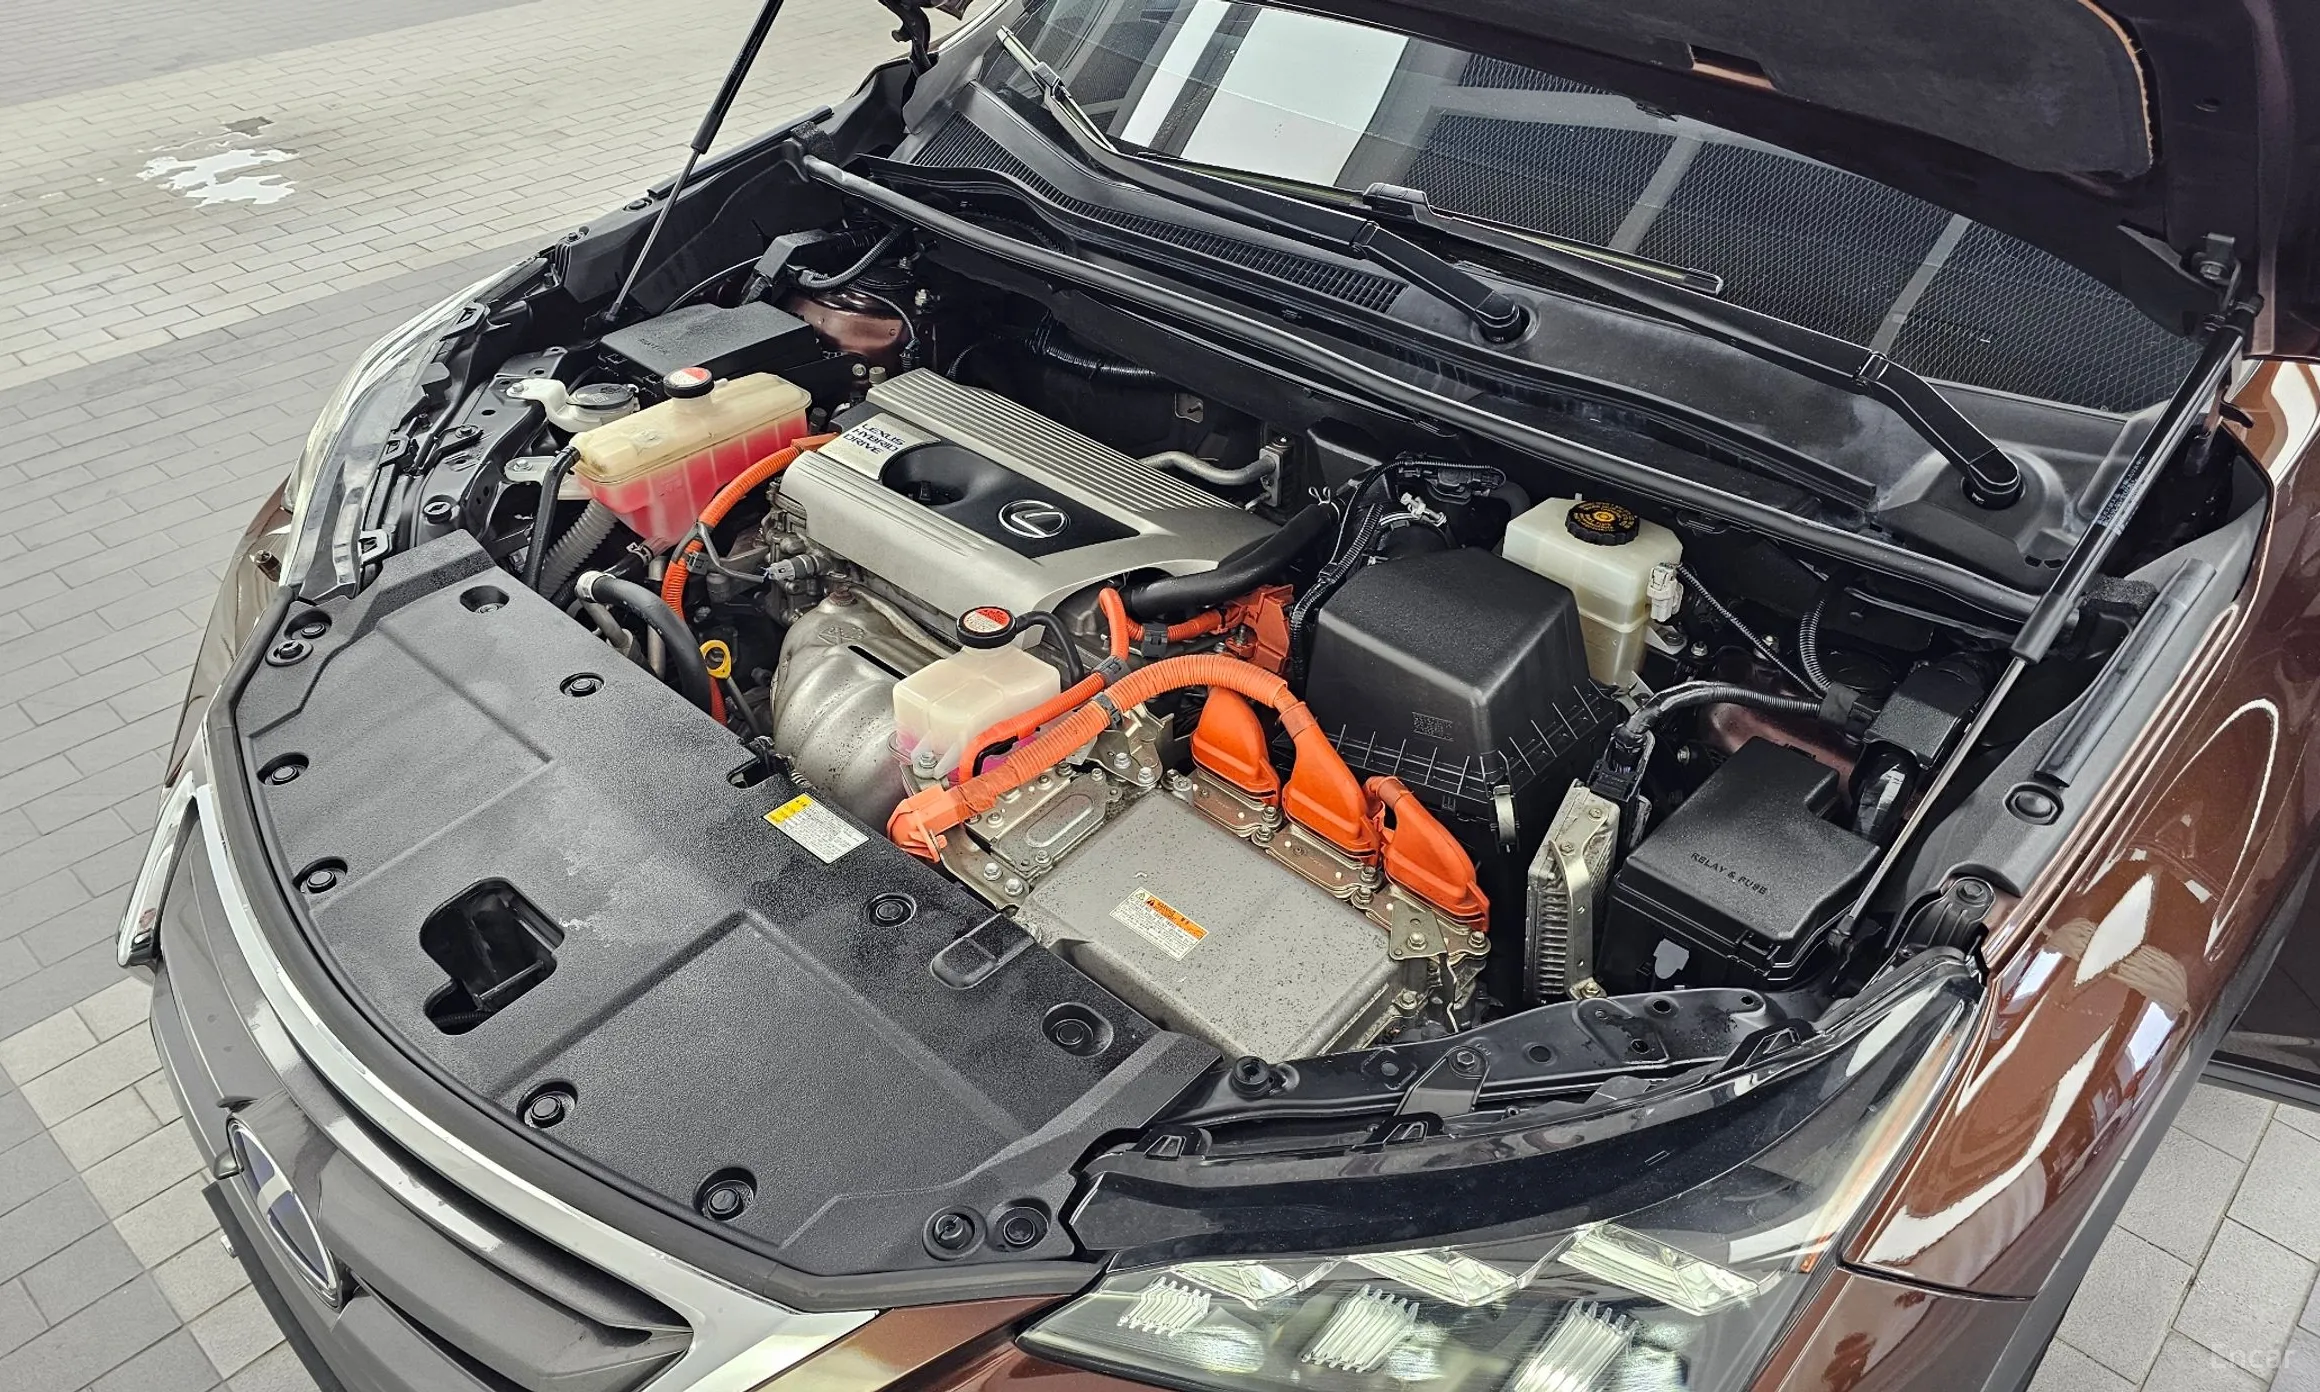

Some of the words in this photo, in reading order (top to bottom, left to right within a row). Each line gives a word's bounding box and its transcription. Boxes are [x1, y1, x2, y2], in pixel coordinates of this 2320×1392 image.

[843, 434, 884, 455] DRIVE
[852, 429, 899, 452] HYBRID
[862, 424, 905, 445] LEXUS
[1690, 852, 1727, 873] RELAY
[1737, 876, 1768, 895] FUSE
